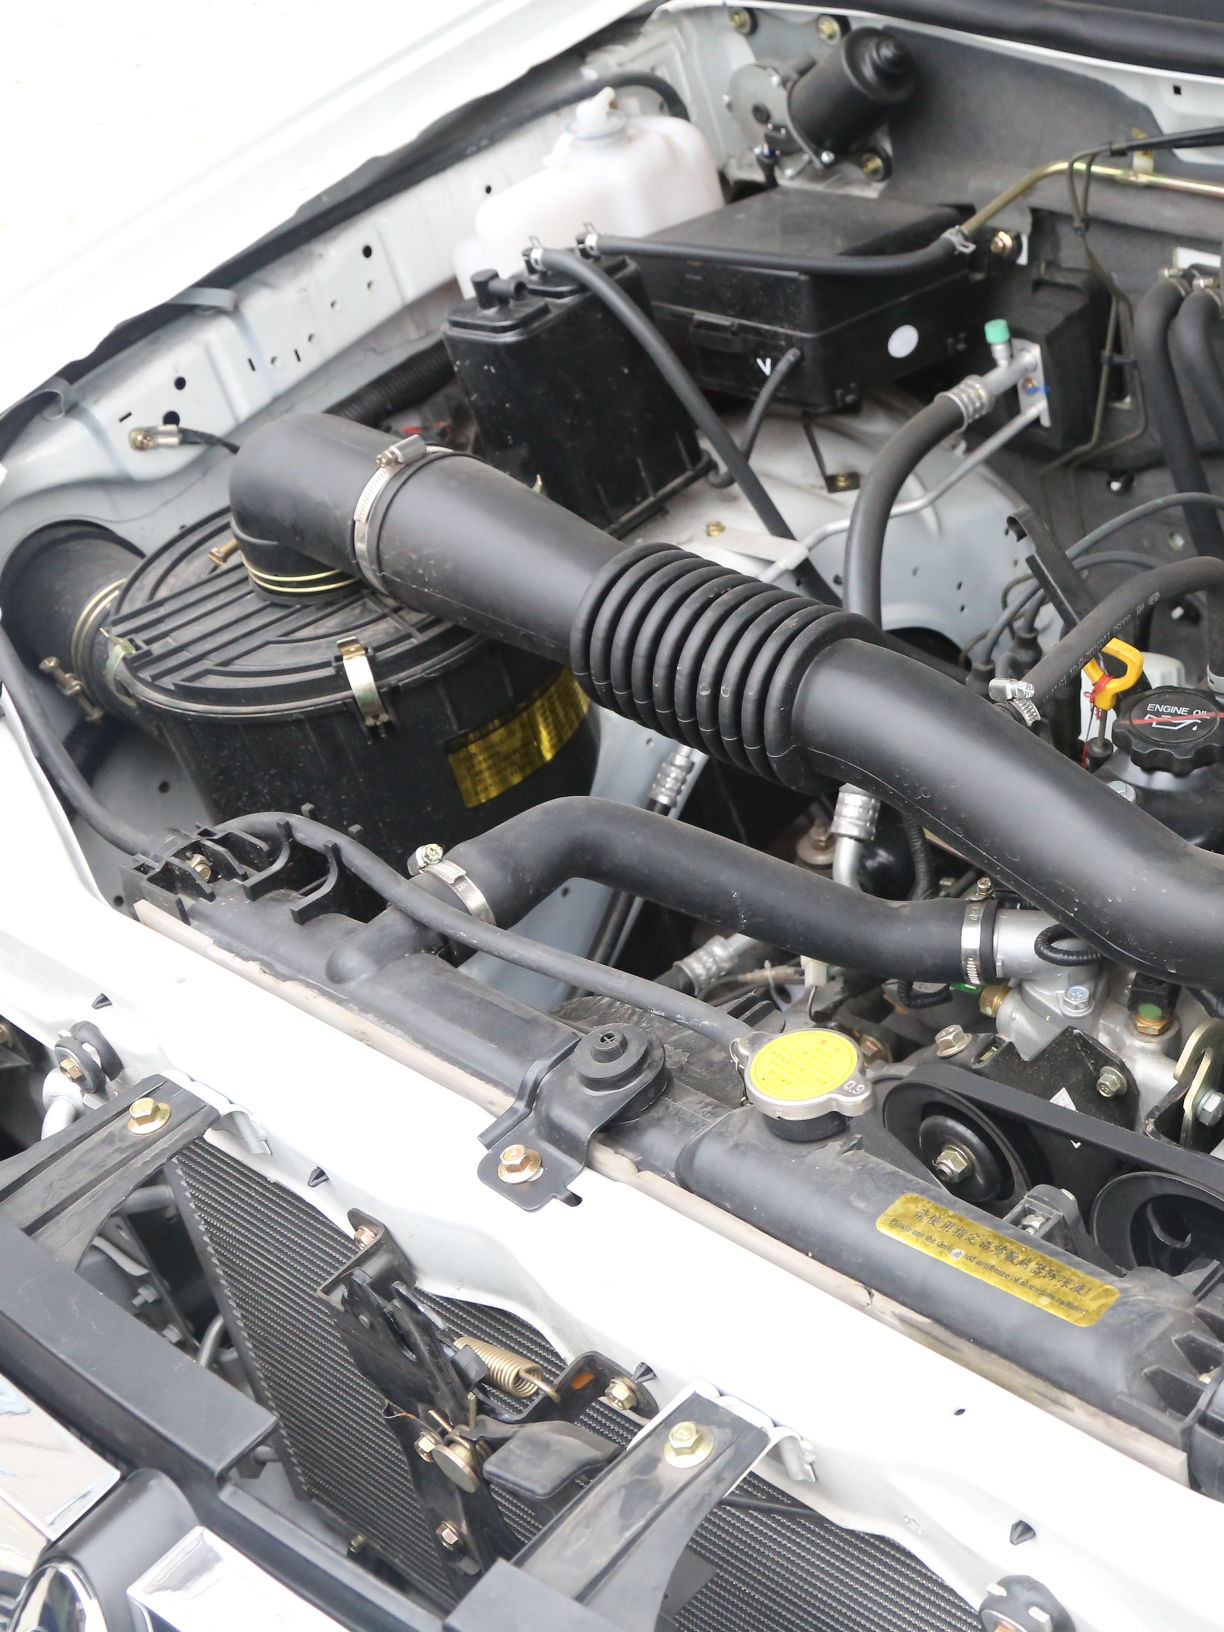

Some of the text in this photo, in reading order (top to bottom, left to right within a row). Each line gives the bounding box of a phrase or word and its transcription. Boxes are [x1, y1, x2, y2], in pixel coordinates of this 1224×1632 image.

[1146, 703, 1190, 716] ENGINE
[843, 1080, 865, 1095] 0.9
[889, 1218, 912, 1232] Please
[912, 1229, 924, 1238] use
[925, 1234, 937, 1243] the
